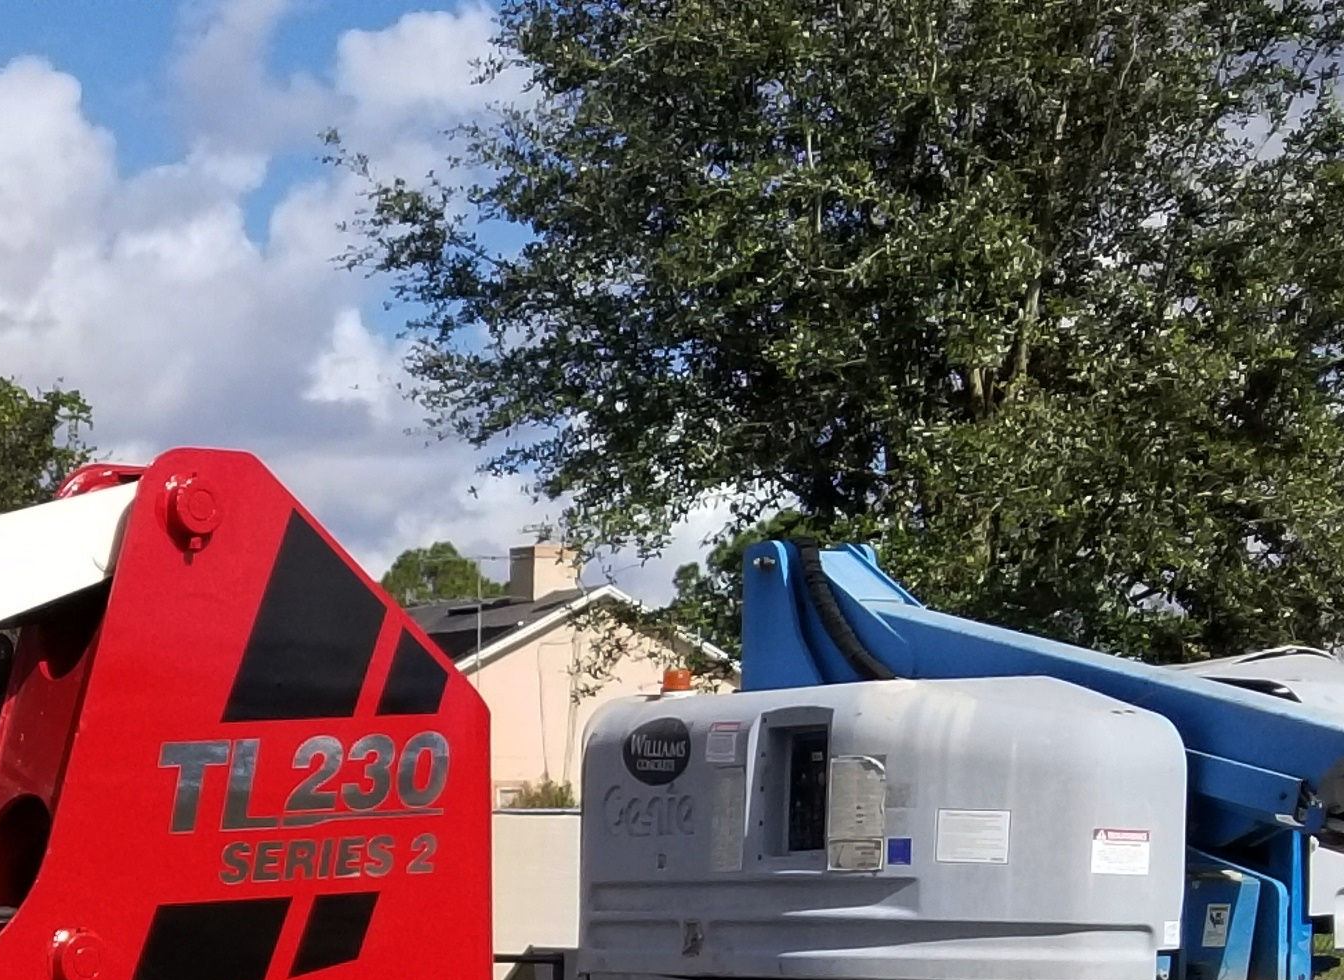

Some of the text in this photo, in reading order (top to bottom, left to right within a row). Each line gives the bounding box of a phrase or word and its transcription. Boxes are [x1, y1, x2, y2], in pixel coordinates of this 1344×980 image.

[630, 734, 686, 757] WILLIAMS
[218, 832, 437, 885] SERIES 2
